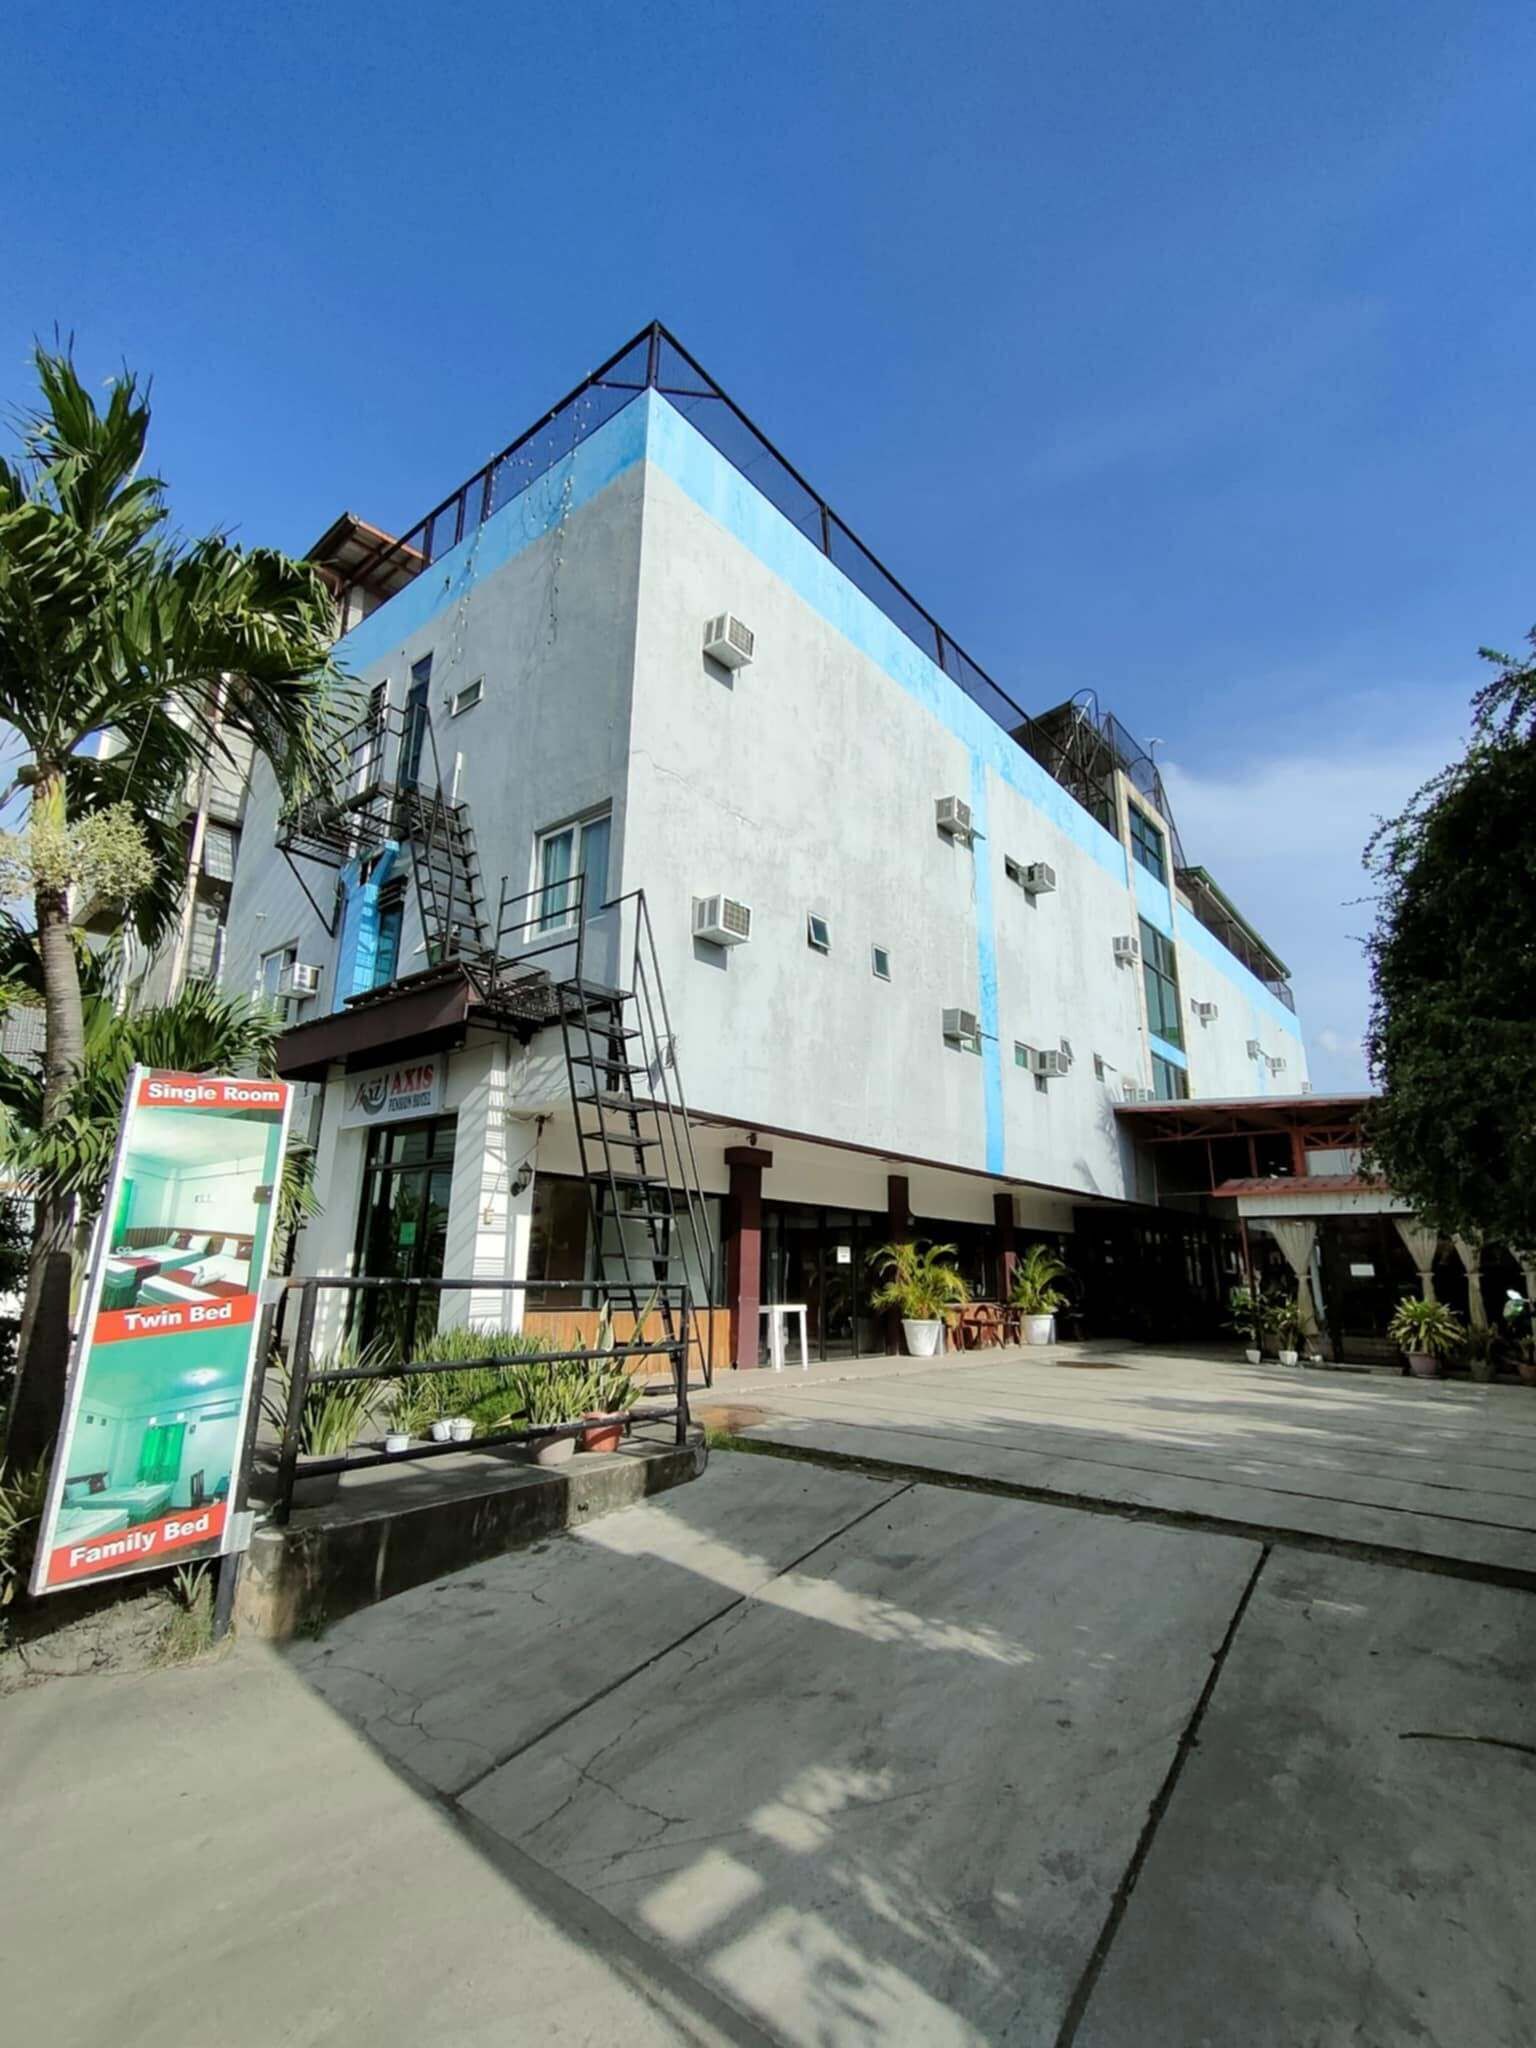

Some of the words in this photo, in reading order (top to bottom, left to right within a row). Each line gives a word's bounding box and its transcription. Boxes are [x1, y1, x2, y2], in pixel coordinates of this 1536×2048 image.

[148, 1083, 217, 1103] Single
[224, 1084, 280, 1102] Room
[391, 1064, 434, 1094] AXIS
[124, 1309, 183, 1330] Twin
[189, 1303, 232, 1323] Bed
[69, 1529, 158, 1568] Family
[163, 1514, 209, 1541] Bed
